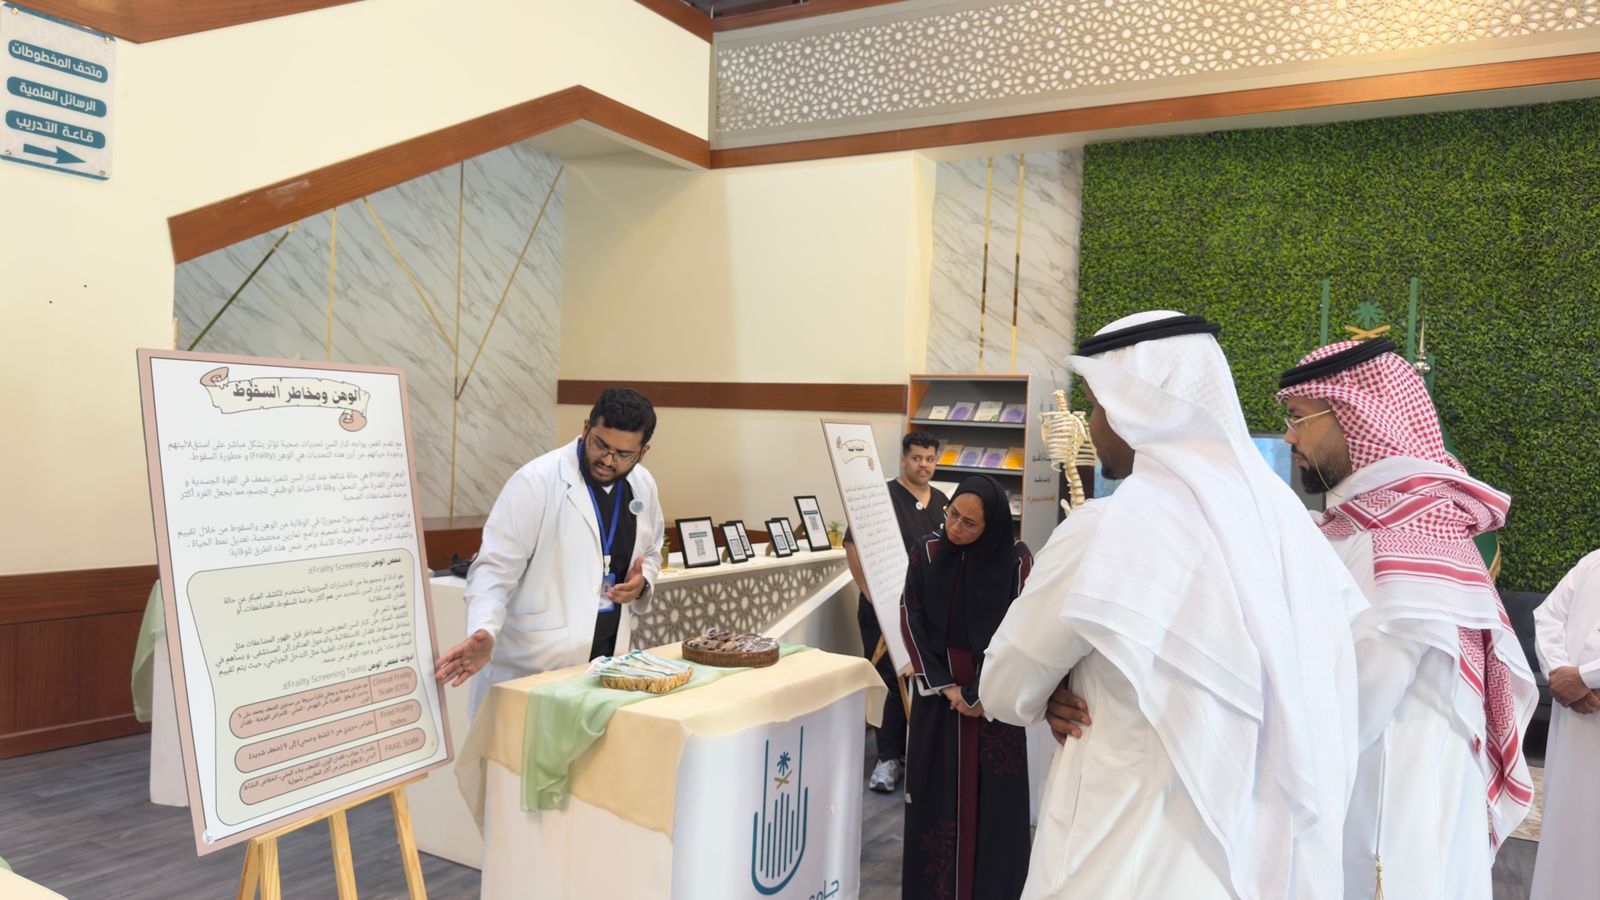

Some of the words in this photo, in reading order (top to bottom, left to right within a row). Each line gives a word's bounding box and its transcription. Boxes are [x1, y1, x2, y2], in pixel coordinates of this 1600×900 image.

[11, 43, 71, 70] المخطوطات
[73, 62, 103, 79] متحف
[18, 82, 59, 102] العلمية
[60, 94, 97, 112] الرسائل
[16, 117, 57, 134] التدريب
[62, 126, 94, 143] قاعة
[232, 382, 281, 402] السقوط
[285, 385, 328, 404] ومخاطر
[332, 389, 361, 405] الوهن
